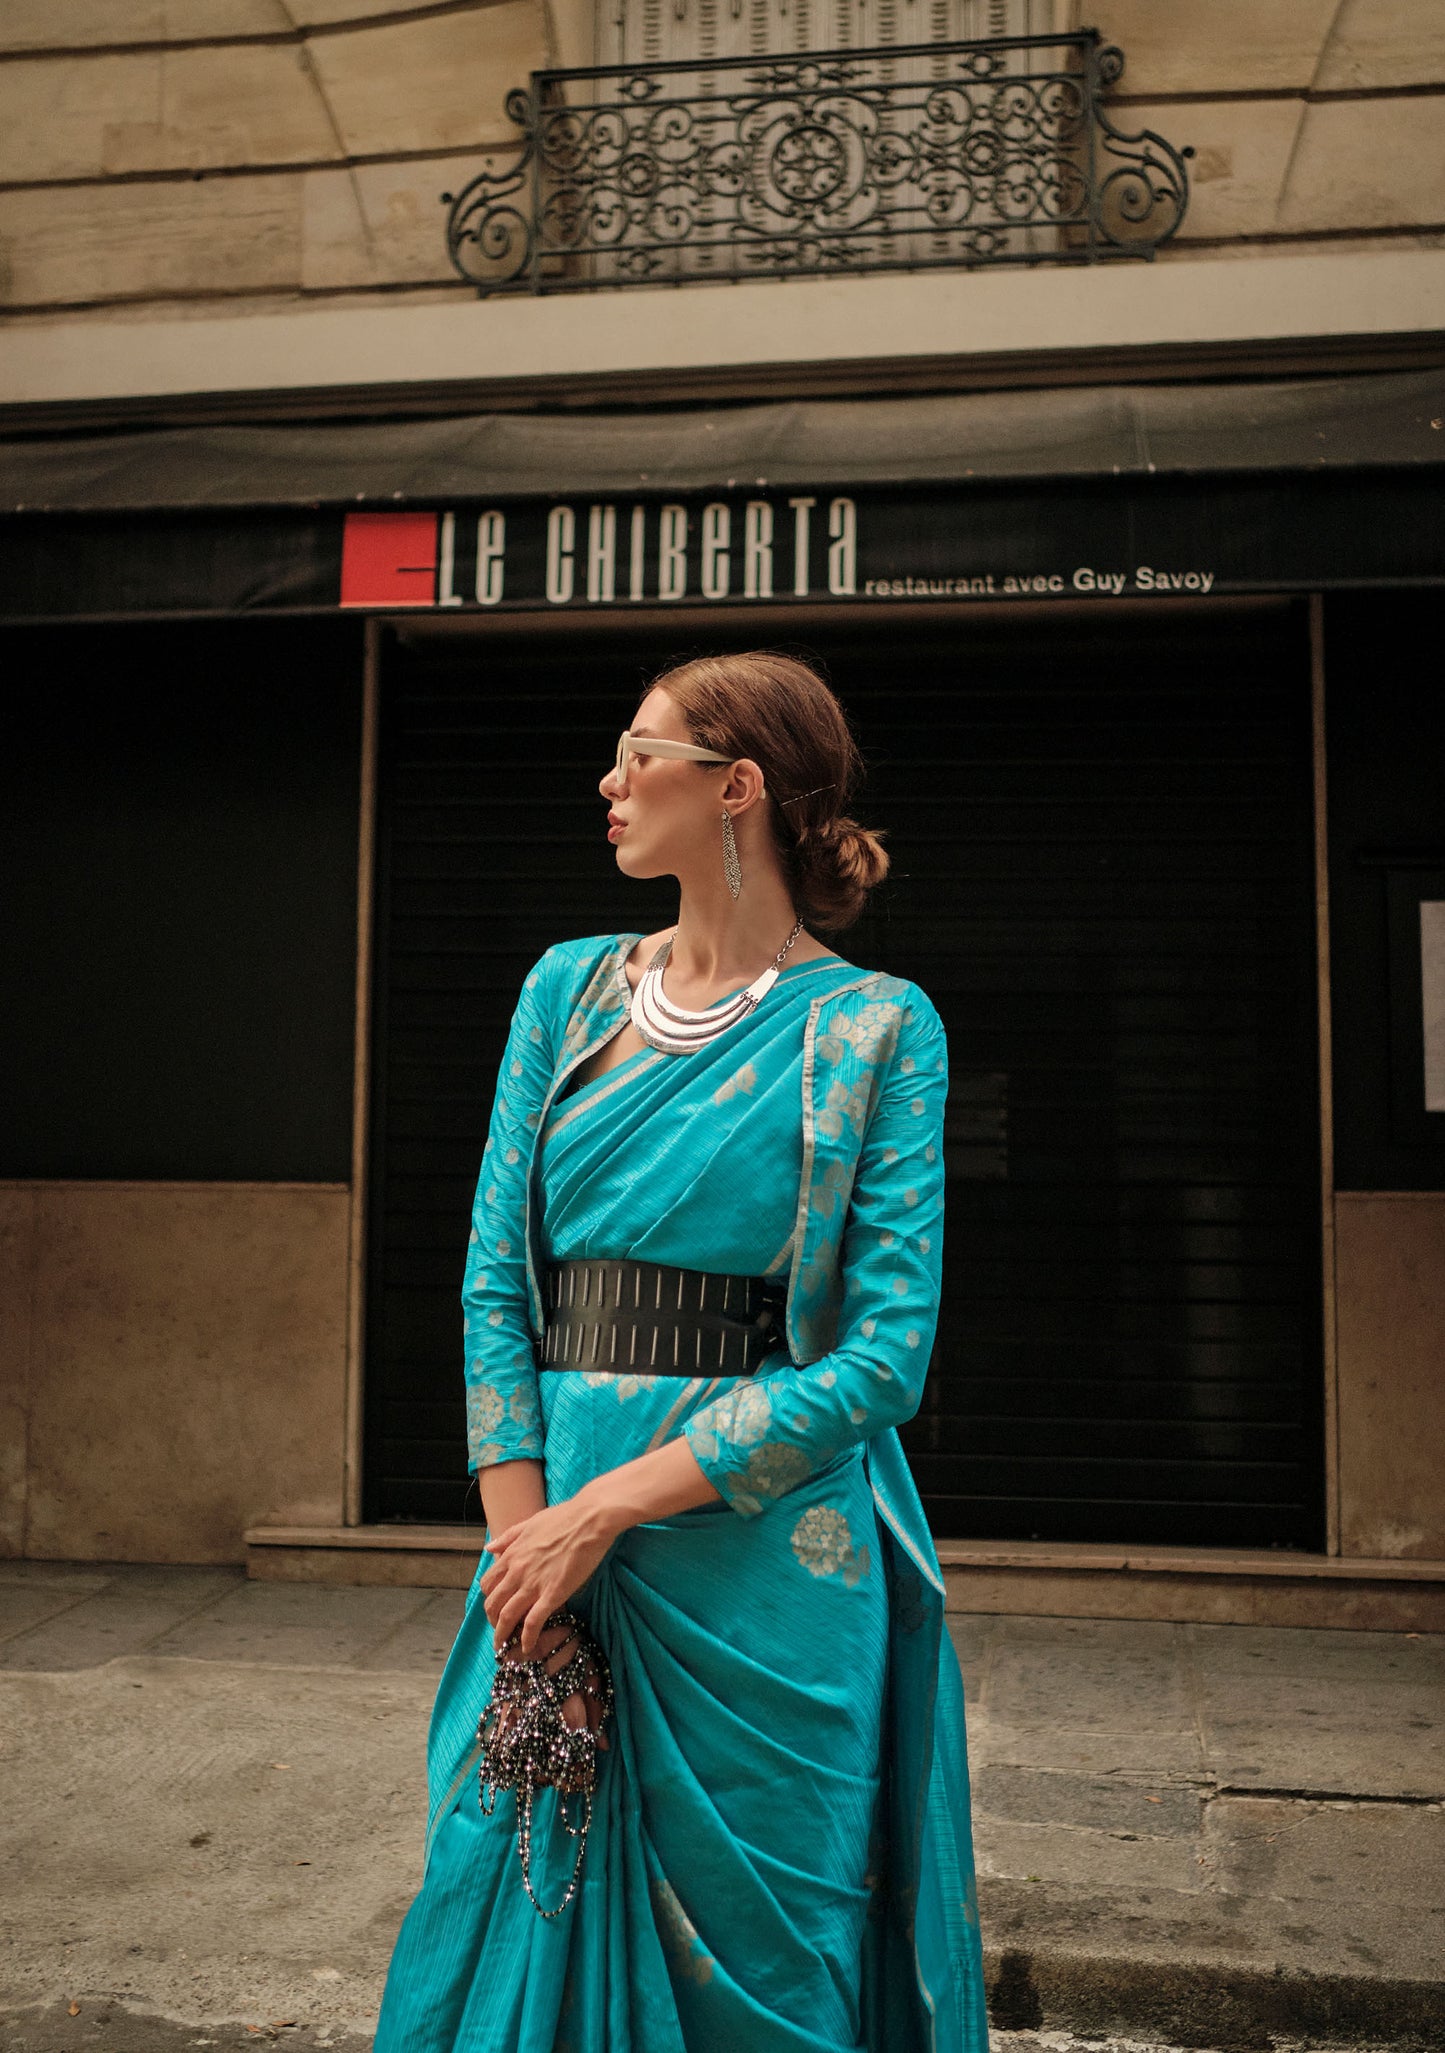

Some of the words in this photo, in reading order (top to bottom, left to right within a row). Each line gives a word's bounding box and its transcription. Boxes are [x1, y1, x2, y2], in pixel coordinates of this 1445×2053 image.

[865, 574, 995, 596] restaurant
[1003, 573, 1064, 593] avec
[1073, 567, 1126, 595] Guy
[1135, 566, 1214, 593] Savoy
